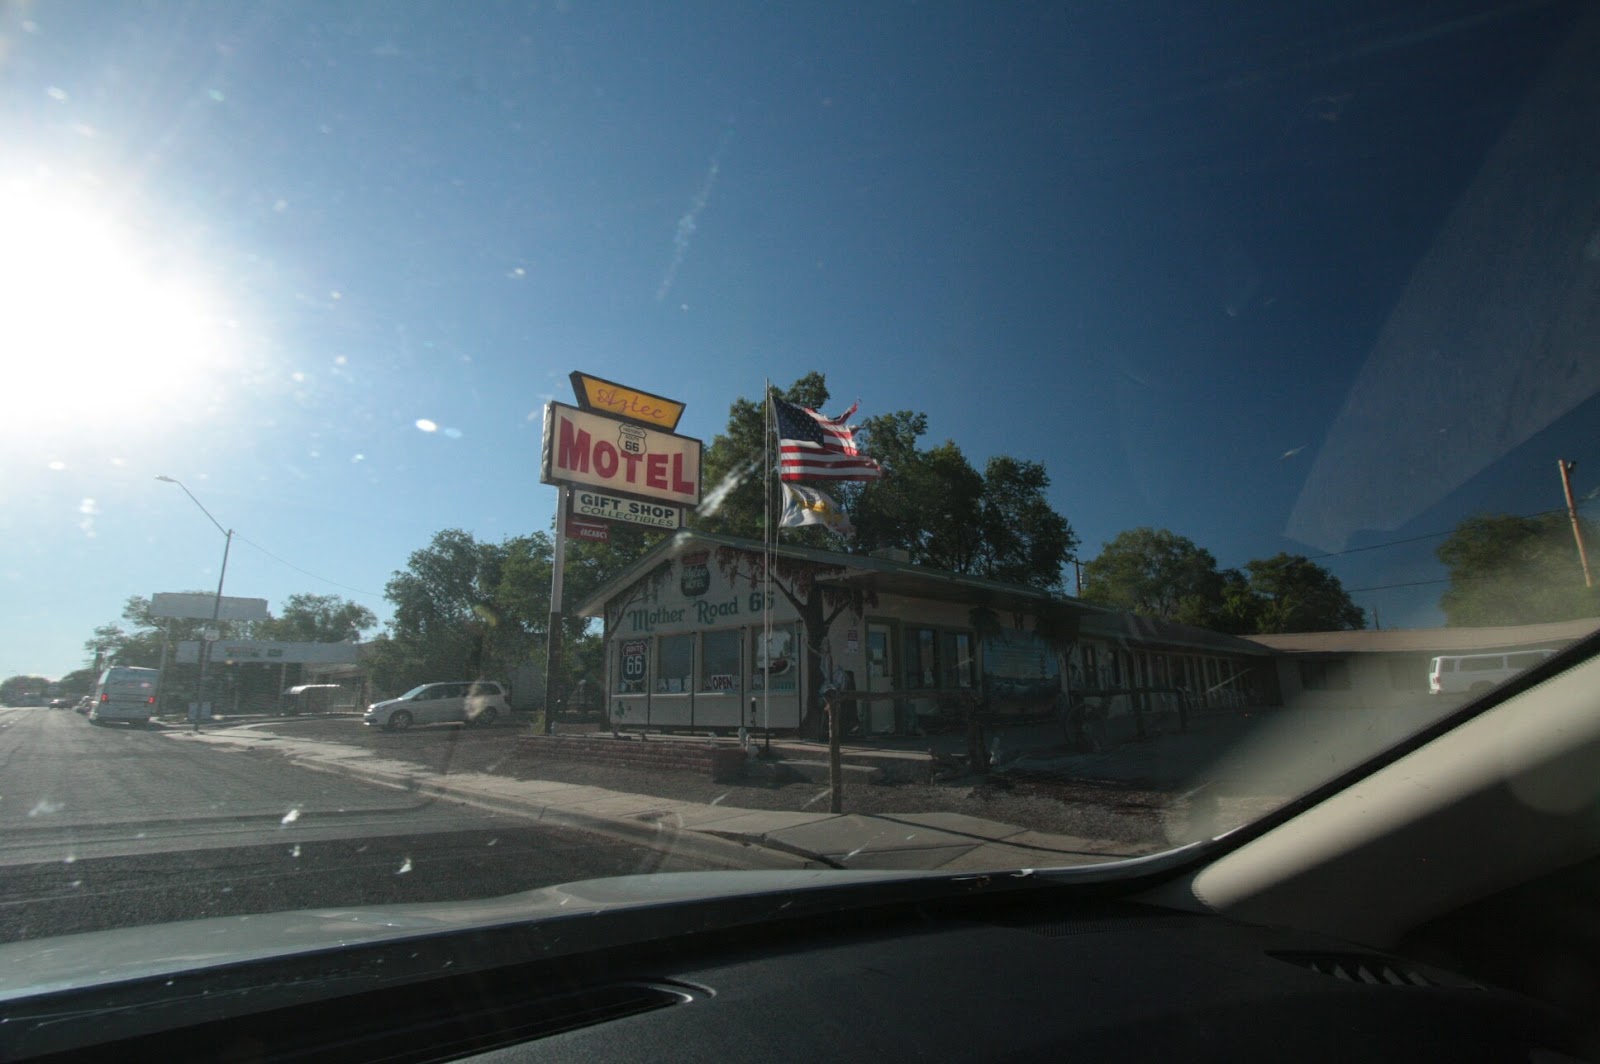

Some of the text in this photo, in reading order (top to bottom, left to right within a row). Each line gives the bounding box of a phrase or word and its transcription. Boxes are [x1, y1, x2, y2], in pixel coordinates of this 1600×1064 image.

[597, 388, 666, 419] Aztec
[558, 416, 695, 495] MOTEL
[625, 440, 640, 452] 66
[580, 493, 675, 519] GIFT SHOP
[580, 505, 674, 528] COLLECTIBLES
[627, 606, 685, 632] Mother
[693, 597, 739, 624] Road
[626, 644, 644, 655] ROUTE
[626, 656, 643, 675] 66
[712, 676, 733, 690] OPEN
